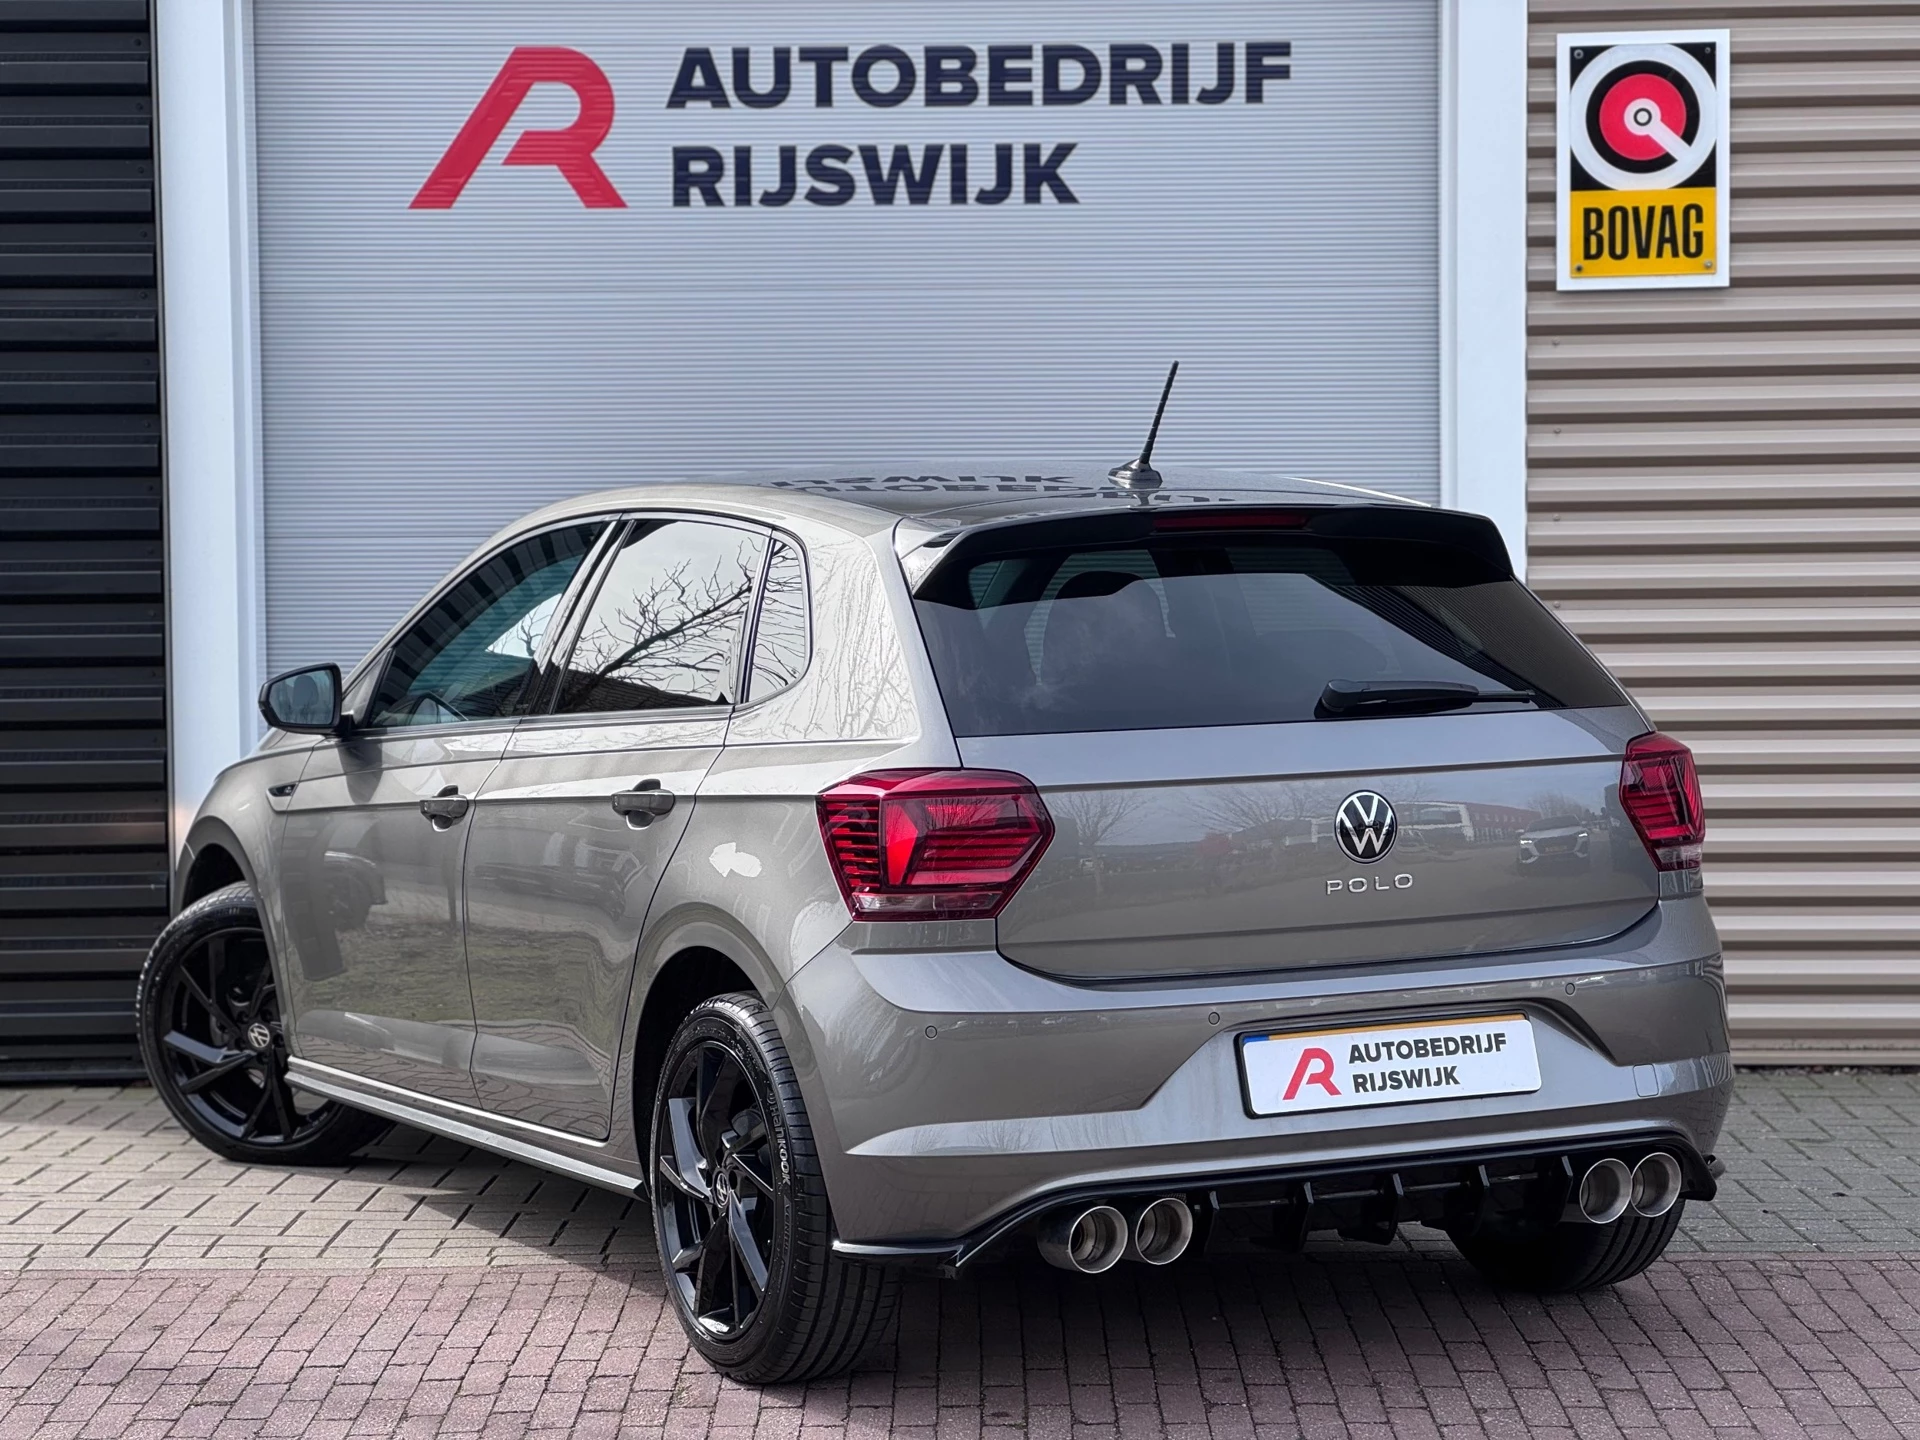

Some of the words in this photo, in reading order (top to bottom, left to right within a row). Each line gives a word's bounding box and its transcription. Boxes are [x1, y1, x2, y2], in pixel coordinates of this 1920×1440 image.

[666, 42, 1292, 109] AUTOBEDRIJF
[672, 143, 1079, 208] RIJSWIJK
[1583, 203, 1704, 261] BOVAG
[1325, 873, 1413, 895] POLO
[1349, 1033, 1507, 1064] AUTOBEDRIJF
[1352, 1065, 1460, 1093] RIJSWIJK
